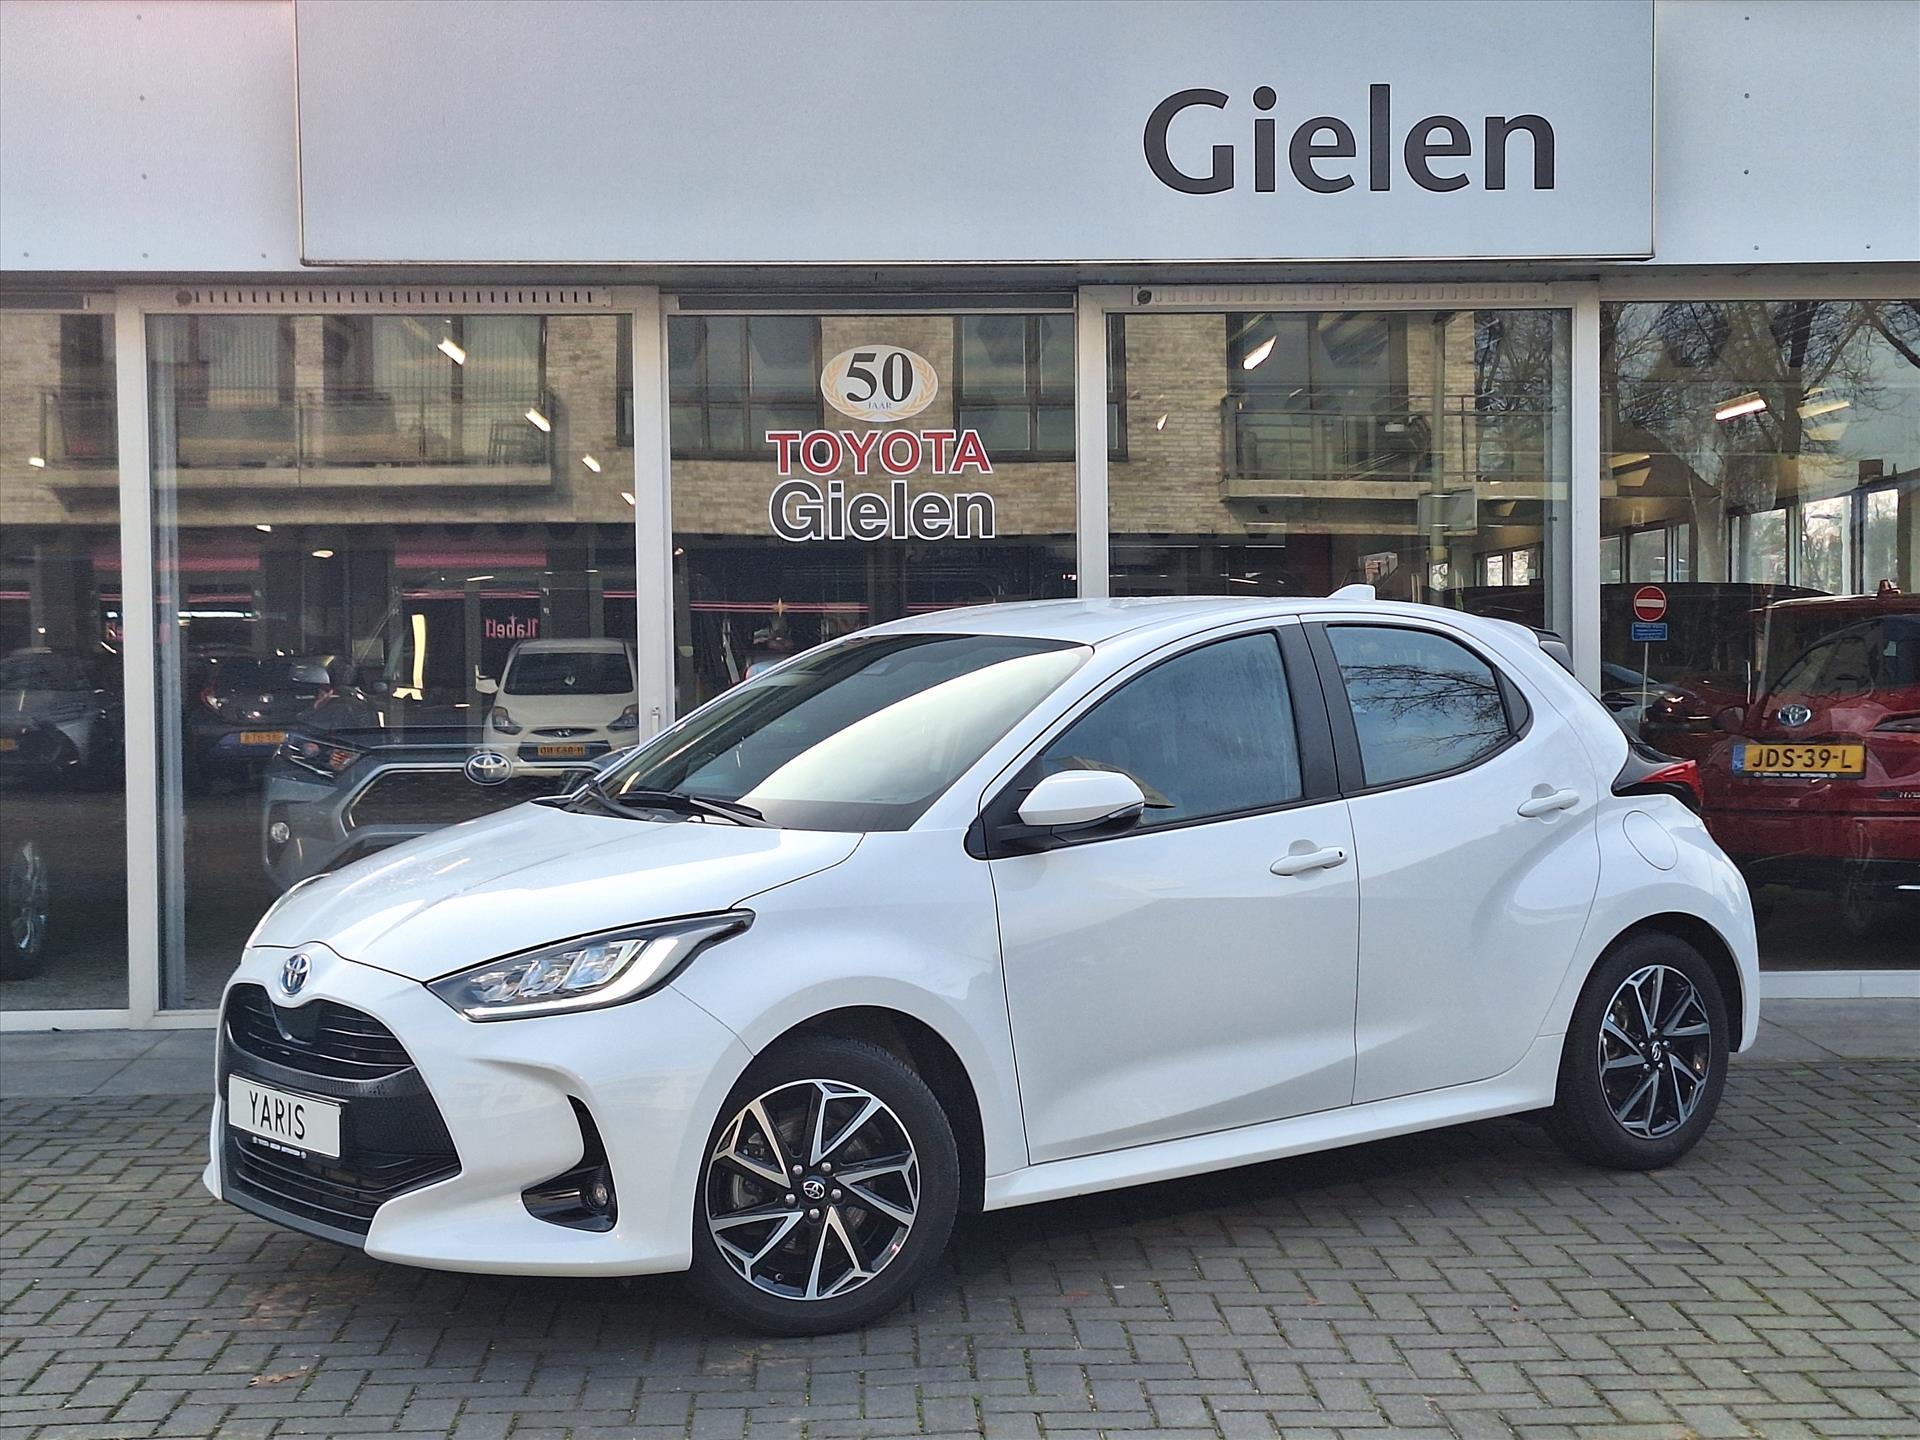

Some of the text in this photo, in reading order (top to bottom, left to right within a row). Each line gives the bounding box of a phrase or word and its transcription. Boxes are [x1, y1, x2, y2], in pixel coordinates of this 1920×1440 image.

[1144, 83, 1555, 195] Gielen
[846, 352, 914, 403] 50
[868, 402, 892, 410] JAAR
[766, 429, 993, 475] TOYOTA
[769, 480, 996, 541] Gielen
[1752, 748, 1852, 769] JDS-39-L
[249, 1090, 305, 1140] YARIS
